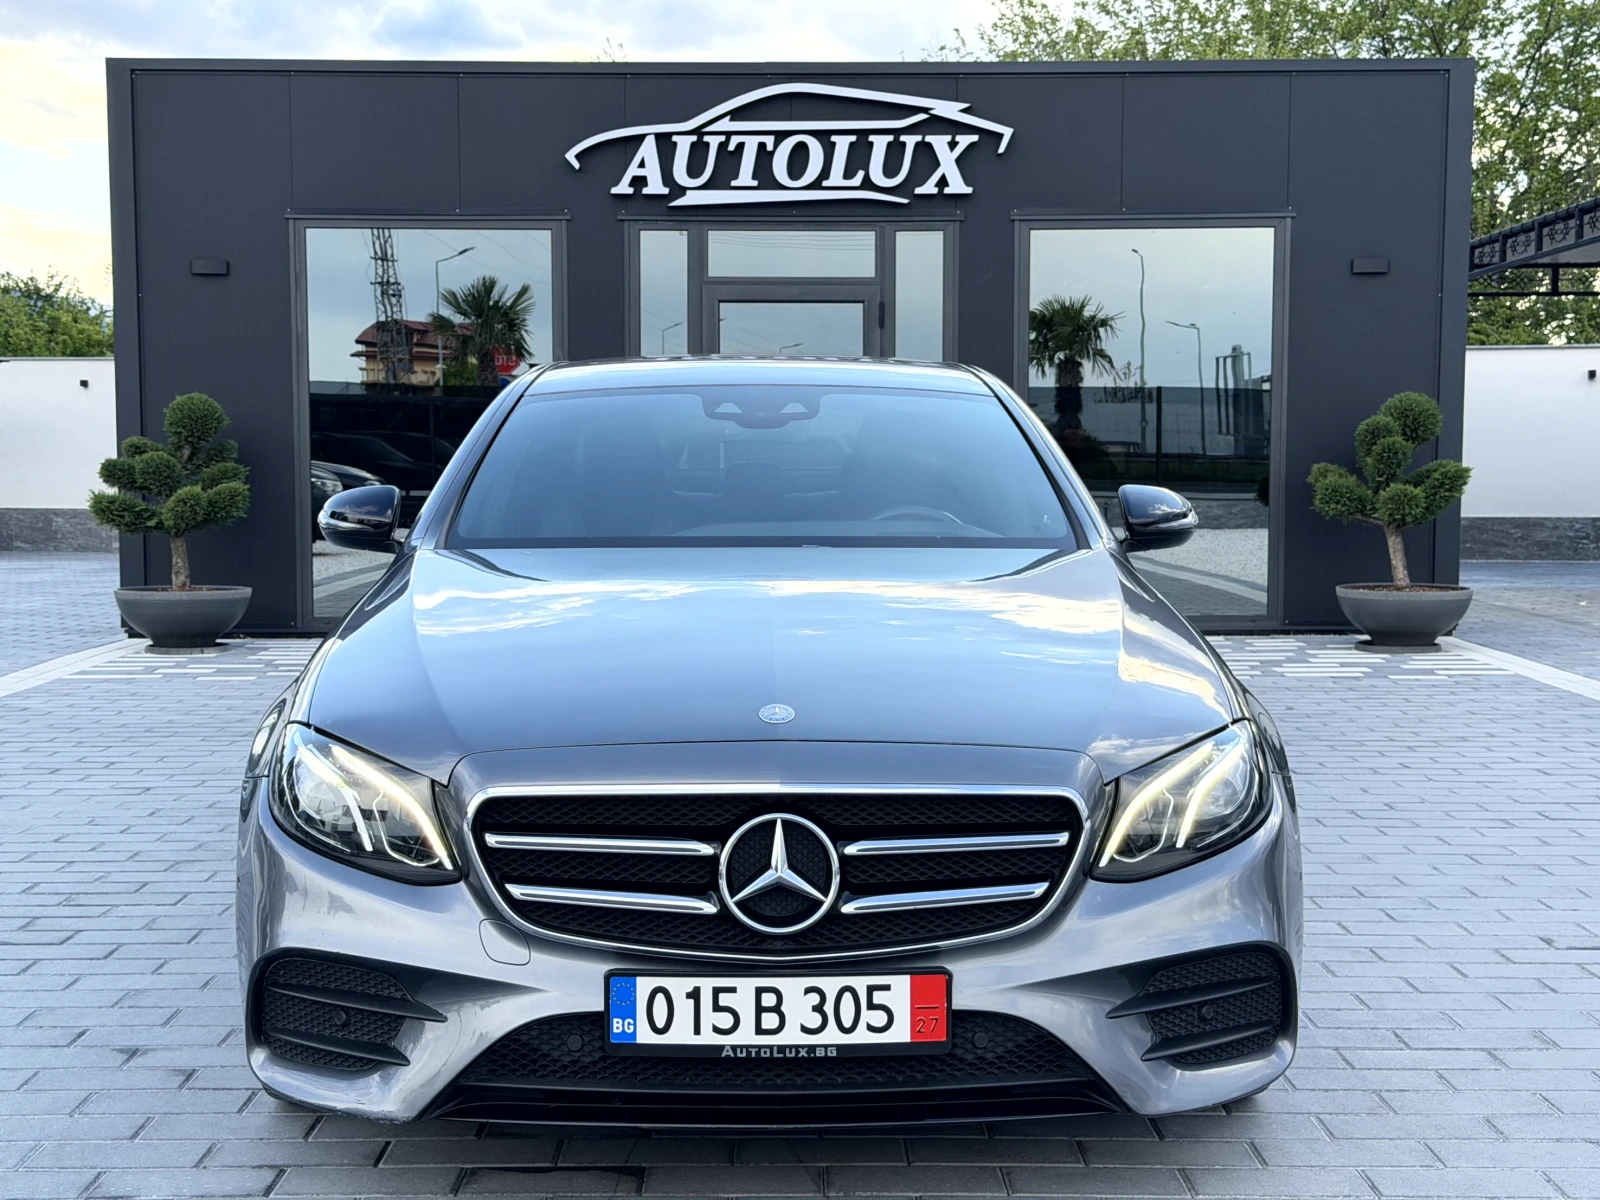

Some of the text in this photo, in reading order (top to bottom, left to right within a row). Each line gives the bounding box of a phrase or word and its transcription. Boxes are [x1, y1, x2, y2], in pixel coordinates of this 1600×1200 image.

[610, 134, 979, 194] AUTOLUX
[612, 1018, 635, 1034] BG
[646, 984, 895, 1036] 015 B 305
[916, 1016, 939, 1034] 27
